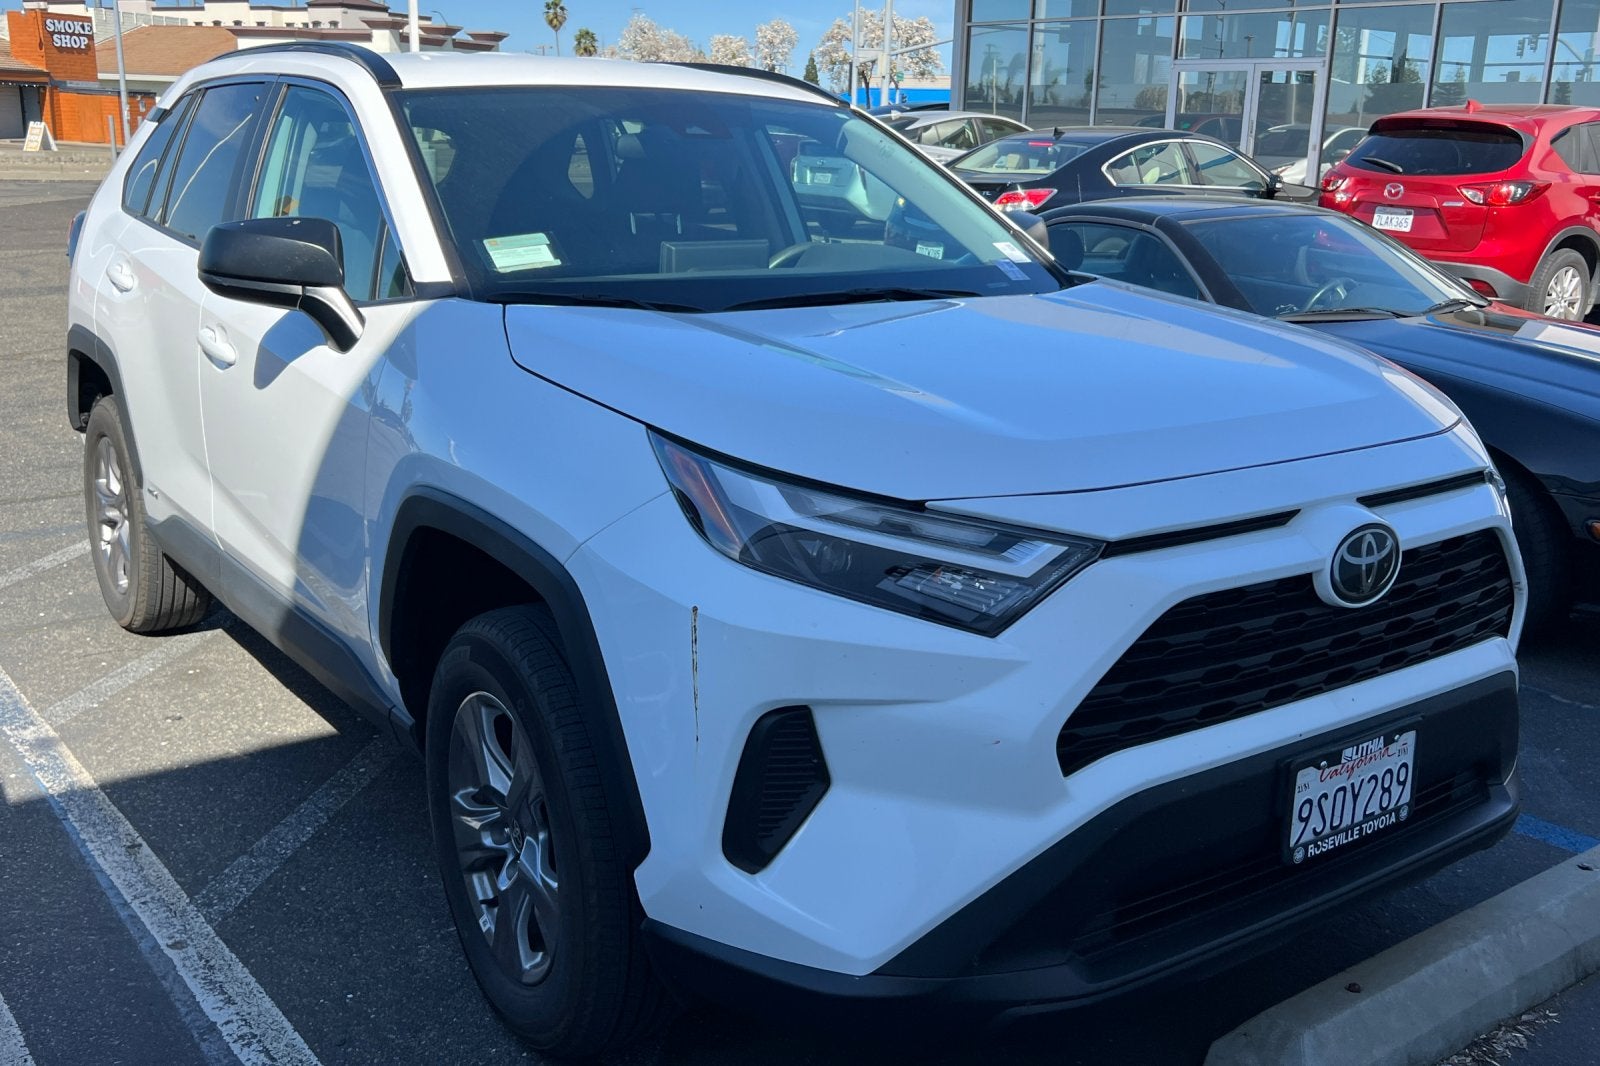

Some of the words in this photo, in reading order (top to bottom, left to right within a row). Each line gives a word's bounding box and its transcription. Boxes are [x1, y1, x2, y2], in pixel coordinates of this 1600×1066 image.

[45, 18, 93, 35] SMOKE
[52, 33, 89, 49] SHOP
[1375, 214, 1409, 229] 7LAK365
[1351, 736, 1385, 762] LITHIA
[1319, 746, 1396, 782] California
[1307, 826, 1361, 858] ROSEVILLE
[1361, 811, 1397, 836] TOYOTA
